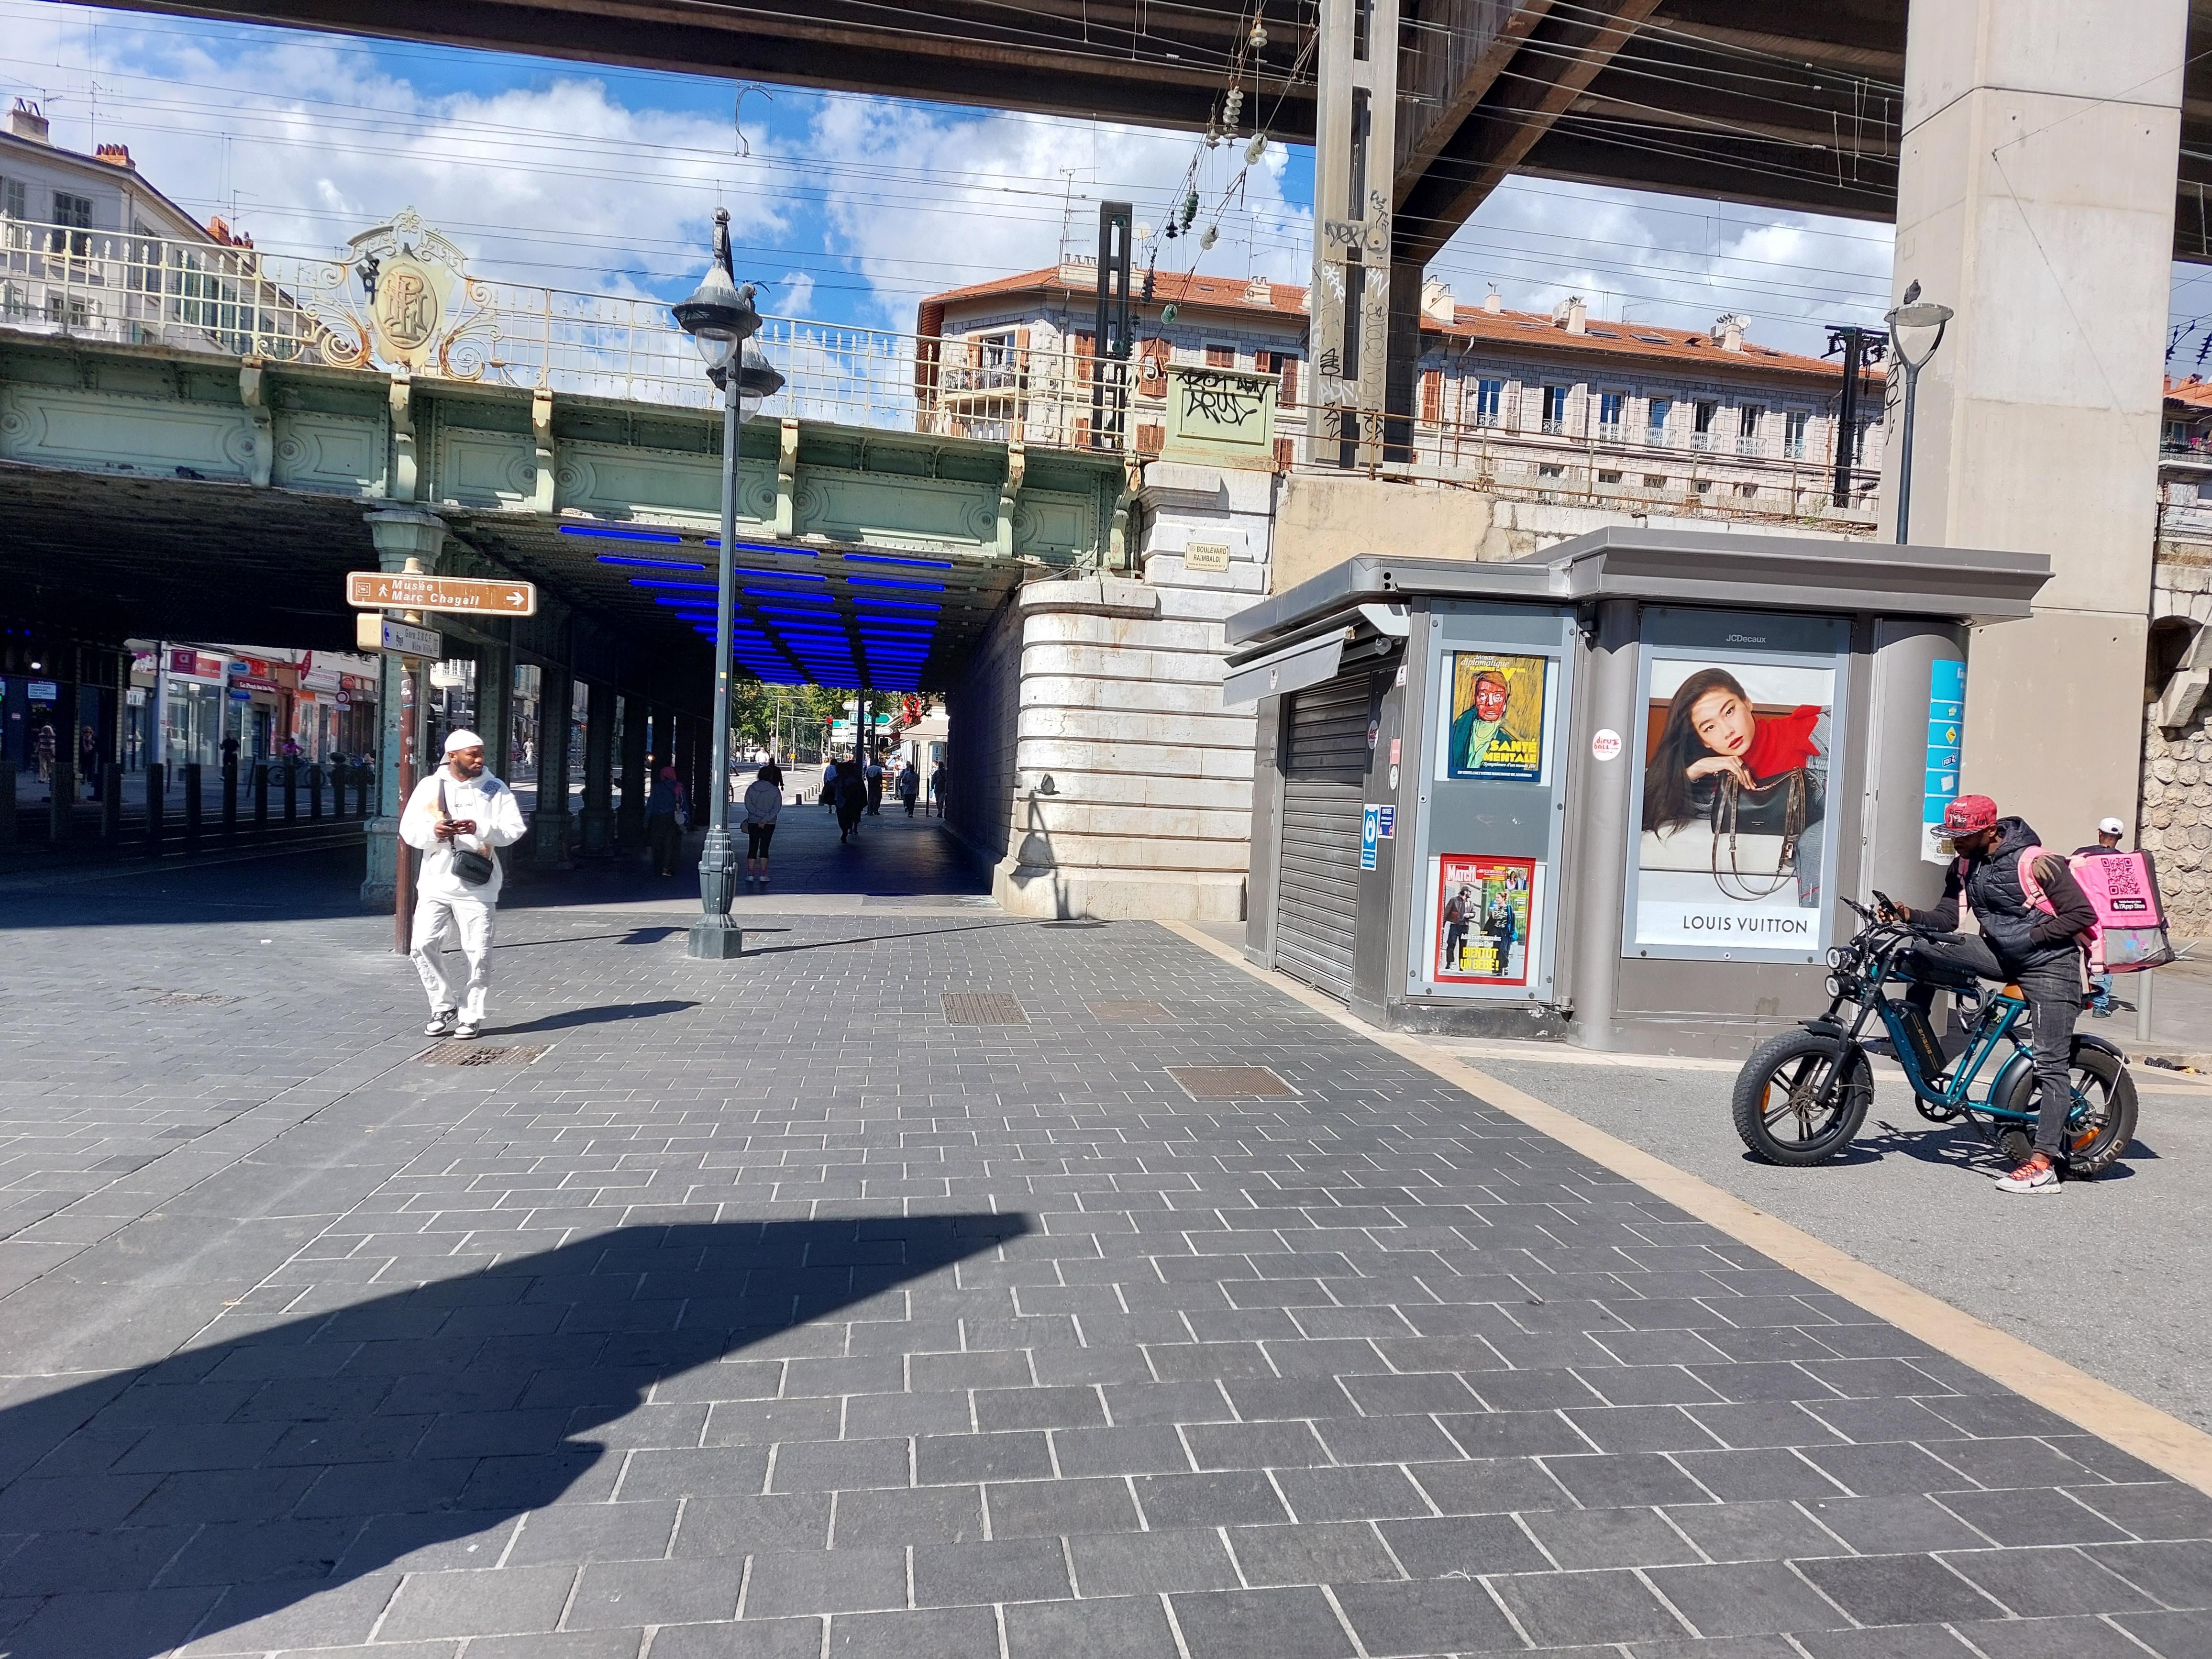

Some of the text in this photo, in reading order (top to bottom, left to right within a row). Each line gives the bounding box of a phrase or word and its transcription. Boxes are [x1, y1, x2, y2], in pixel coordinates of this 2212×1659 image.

[1196, 546, 1227, 554] BOULEVARD
[391, 580, 433, 591] Musée
[391, 591, 480, 606] Marc Chagall
[405, 628, 416, 639] Gare
[1726, 634, 1766, 643] JCDecaux
[1460, 658, 1510, 668] diplomatique
[1490, 738, 1537, 752] SANTÉ
[1483, 752, 1537, 763] MENTALE
[1683, 915, 1807, 933] LOUIS VUITTON
[1460, 958, 1472, 969] UN
